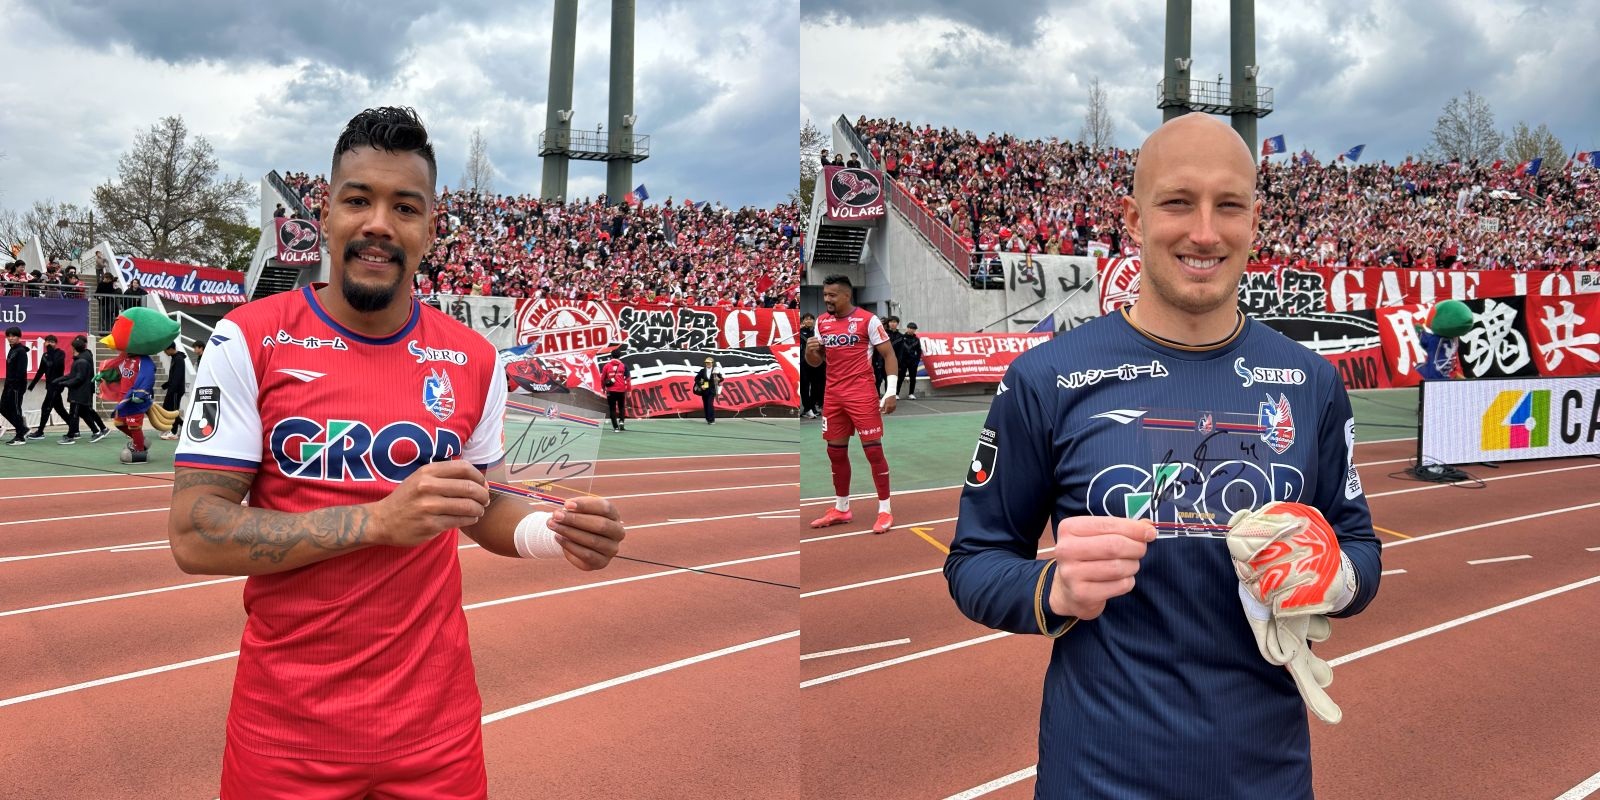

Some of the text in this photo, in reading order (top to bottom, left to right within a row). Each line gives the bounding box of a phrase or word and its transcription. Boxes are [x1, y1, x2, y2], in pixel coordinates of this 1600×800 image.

[832, 205, 884, 218] VOLARE
[280, 251, 321, 262] VOLARE
[115, 256, 240, 294] Brucia il cuore
[1010, 258, 1094, 298] 岡山
[1283, 269, 1322, 291] PER
[1330, 269, 1480, 312] GATE
[620, 307, 717, 331] SIAMO PER
[724, 309, 800, 348] GA
[262, 330, 348, 351] ヘシーホーム
[629, 323, 719, 350] SEMPRE
[920, 336, 951, 356] ONE
[953, 336, 996, 357] STEP
[1460, 299, 1531, 378] 魂
[1537, 300, 1600, 372] 共
[1057, 360, 1169, 389] ヘルシーホーム
[1254, 367, 1306, 385] SERIO
[1337, 355, 1379, 389] ANO
[669, 381, 692, 403] OF
[715, 374, 791, 406] AGIANO
[270, 416, 462, 483] GROP
[1086, 460, 1304, 539] GROP
